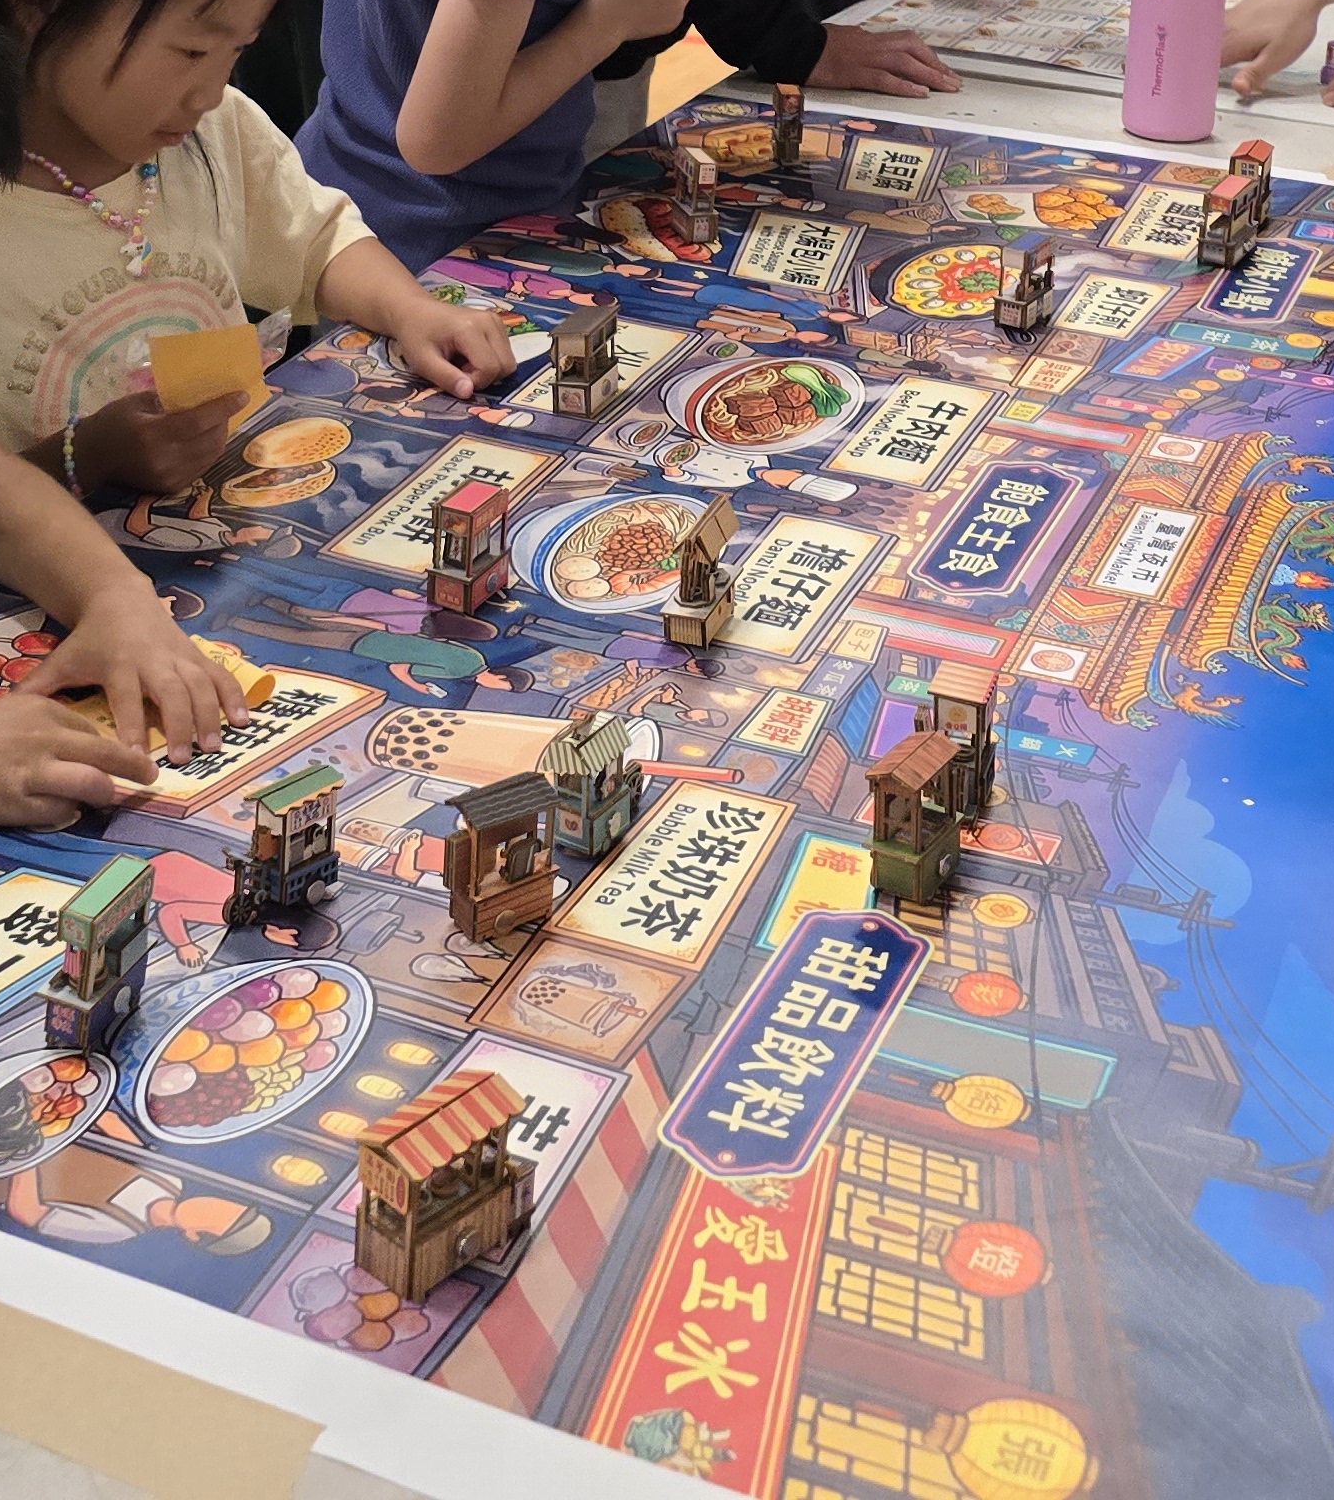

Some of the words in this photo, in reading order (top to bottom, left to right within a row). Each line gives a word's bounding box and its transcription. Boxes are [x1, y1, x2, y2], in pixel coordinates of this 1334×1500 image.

[873, 150, 923, 193] 臭豆腐
[773, 224, 796, 252] Taiwanese
[1118, 225, 1143, 246] Chicken
[1145, 201, 1210, 246] 鹽酥雞
[780, 222, 840, 286] 大腸包小腸
[1220, 245, 1300, 312] 鹹味小點
[41, 266, 127, 331] YOUR
[1085, 286, 1153, 329] 蚵仔煎
[899, 389, 921, 407] Beef
[871, 406, 903, 437] Noodle
[876, 400, 969, 465] 牛肉麵
[439, 449, 475, 472] Black
[847, 435, 881, 458] Soup
[403, 474, 448, 505] Pepper
[375, 504, 411, 527] Pork
[938, 479, 1050, 578] 飽食主食
[1132, 511, 1158, 534] Taiwan
[353, 526, 385, 545] Bun
[755, 538, 793, 569] Danzi
[1119, 535, 1143, 556] Night
[1132, 522, 1185, 583] 臺灣夜市
[733, 568, 769, 607] Noodl
[742, 540, 855, 630] 擔仔麵
[1102, 556, 1131, 584] Market
[848, 627, 876, 652] 包子
[815, 659, 855, 698] 冬瓜茶
[753, 696, 818, 745] 胡椒餅
[649, 802, 696, 846] Bubble
[621, 801, 766, 943] 珍珠奶茶
[631, 846, 658, 878] Milk
[594, 881, 636, 906] Tea
[707, 938, 890, 1139] 甜品飲料
[969, 1238, 1025, 1281] 燈
[653, 1205, 789, 1399] 愛玉冰
[992, 1431, 1057, 1484] 張
